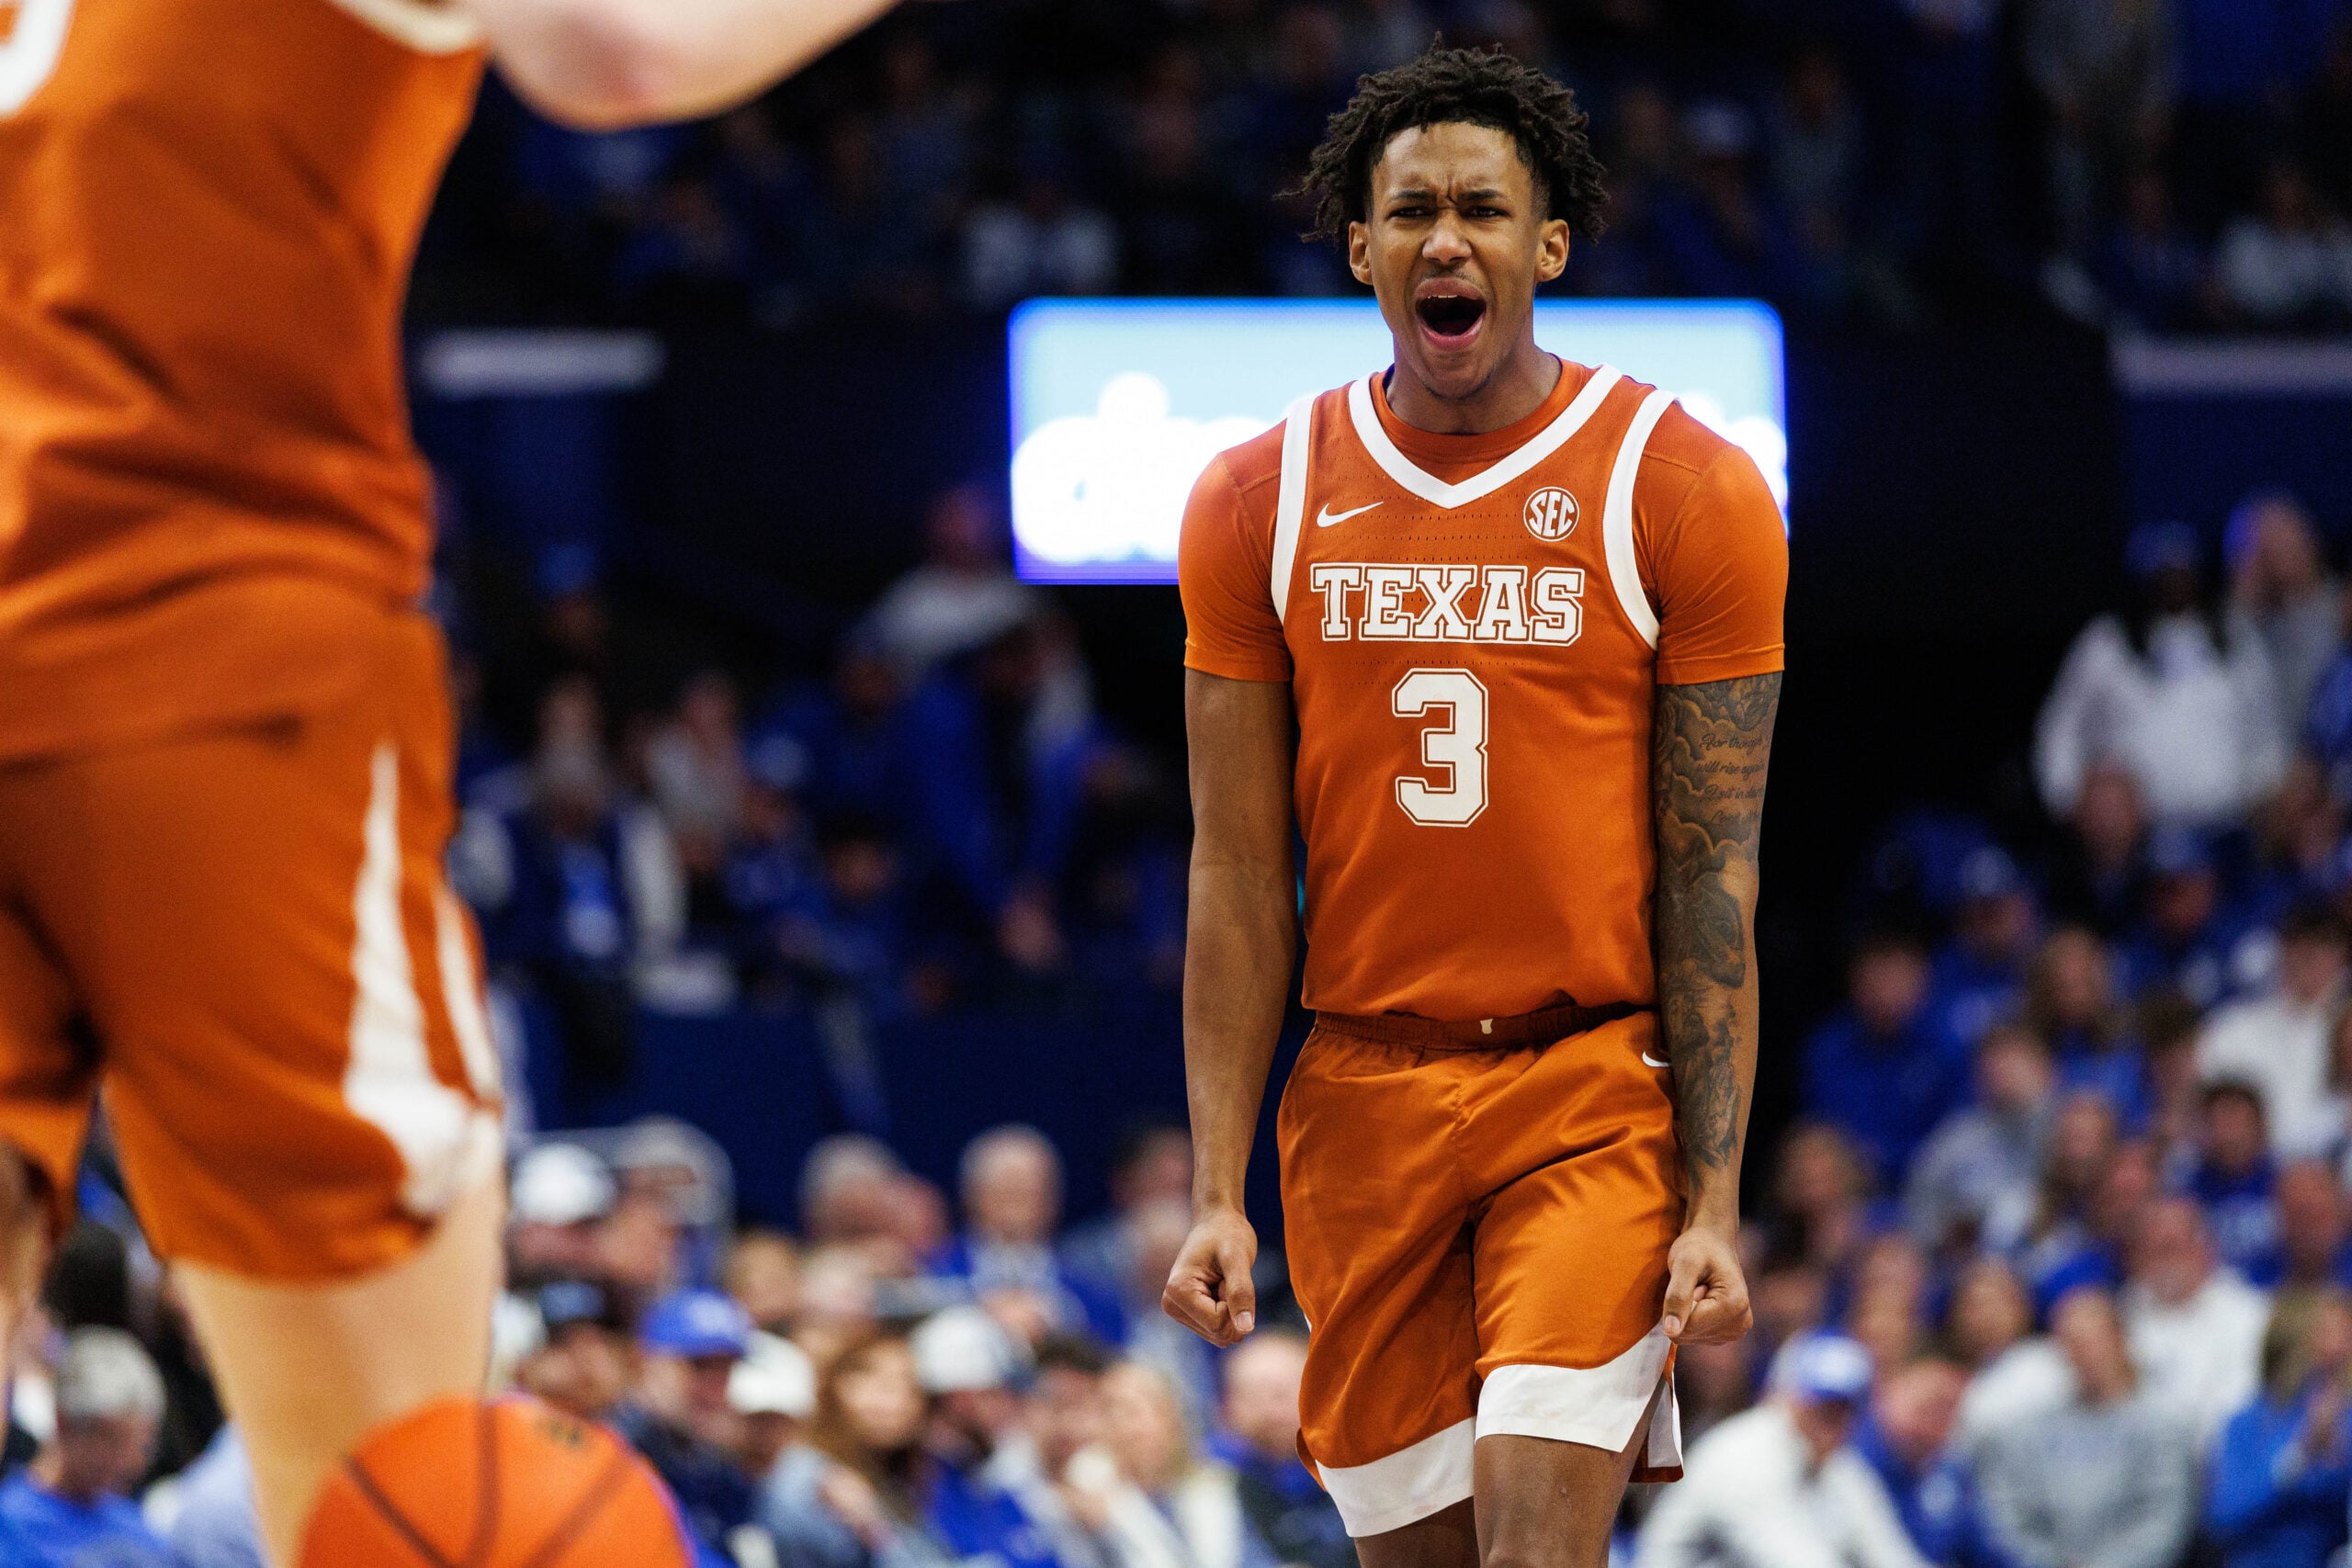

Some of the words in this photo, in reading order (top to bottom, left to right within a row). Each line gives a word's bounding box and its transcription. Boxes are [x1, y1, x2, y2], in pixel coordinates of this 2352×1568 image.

[1528, 491, 1575, 537] SEC
[1310, 562, 1586, 647] TEXAS
[1392, 668, 1488, 828] 3
